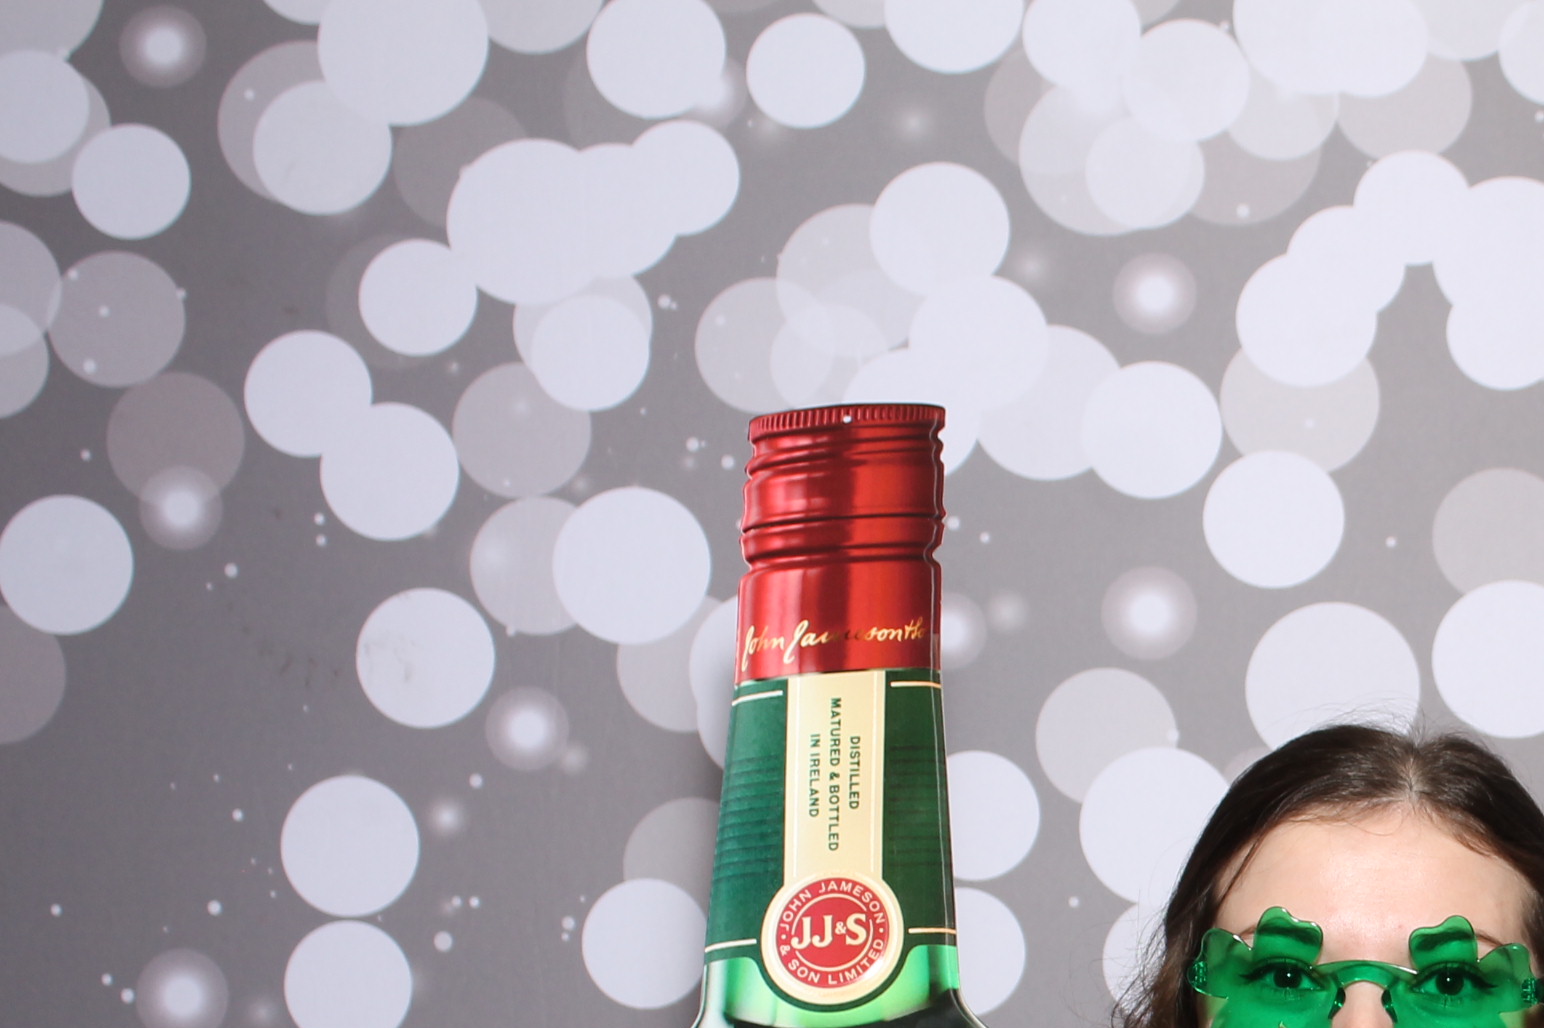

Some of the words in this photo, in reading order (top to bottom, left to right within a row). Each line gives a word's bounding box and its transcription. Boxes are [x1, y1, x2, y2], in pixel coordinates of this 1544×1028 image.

[810, 733, 821, 748] IN
[829, 697, 842, 767] MATURED
[808, 752, 821, 818] IRELAND
[829, 771, 841, 781] &
[849, 735, 861, 810] DISTILLED
[828, 784, 841, 852] BOTTLED
[779, 888, 812, 932] JOHN
[818, 880, 886, 924] JAMESON
[790, 912, 868, 950] JJ&S
[779, 944, 791, 957] &
[788, 958, 820, 984] SON
[827, 938, 884, 985] LIMITED
